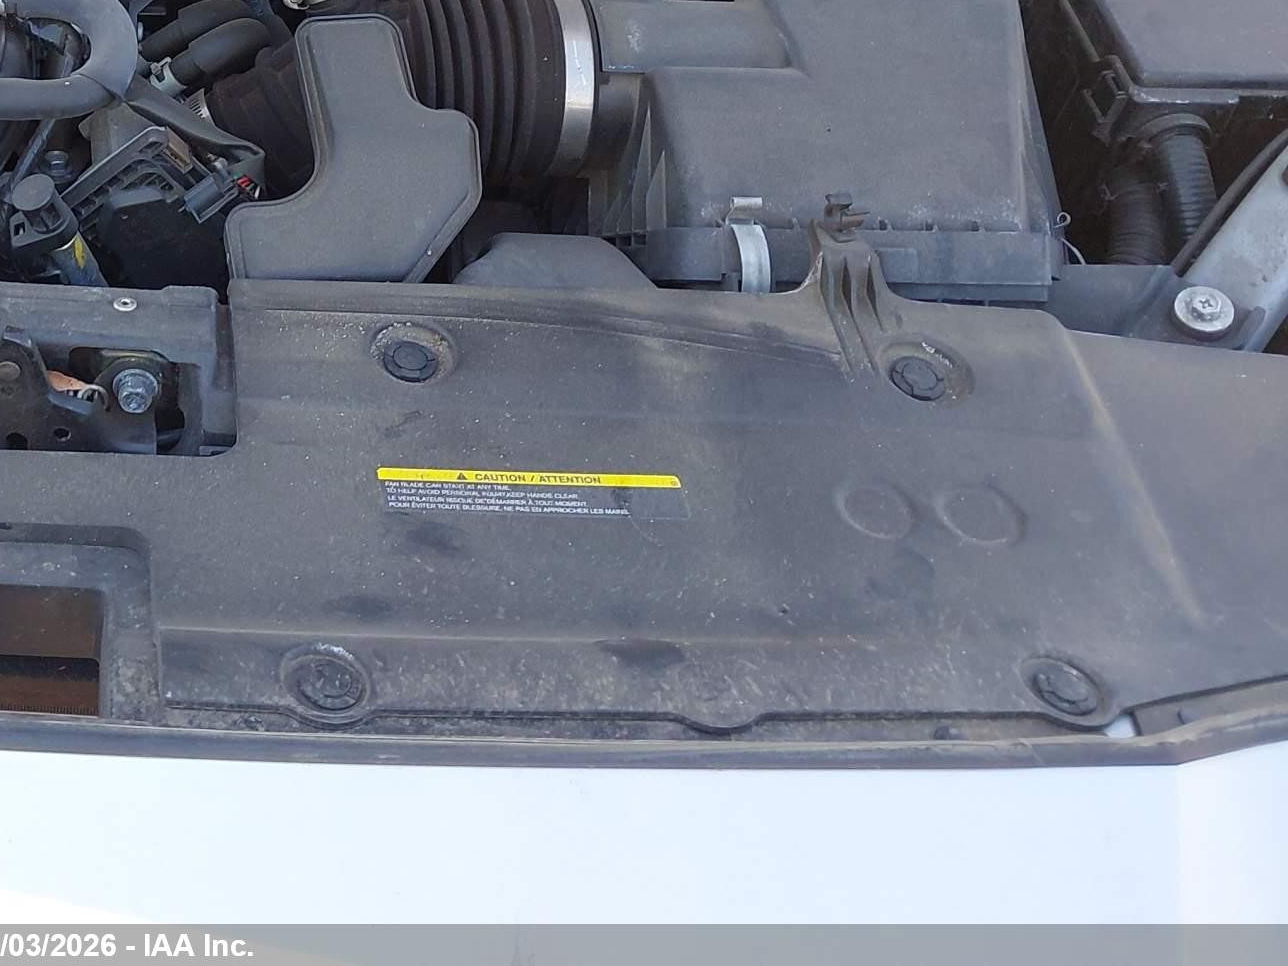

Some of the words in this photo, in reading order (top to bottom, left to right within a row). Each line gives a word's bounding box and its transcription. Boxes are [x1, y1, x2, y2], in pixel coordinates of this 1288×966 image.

[474, 473, 527, 483] CAUTION
[539, 475, 601, 484] ATTENTION
[398, 495, 445, 503] VENTILATEUR
[543, 506, 589, 514] APPROCHER
